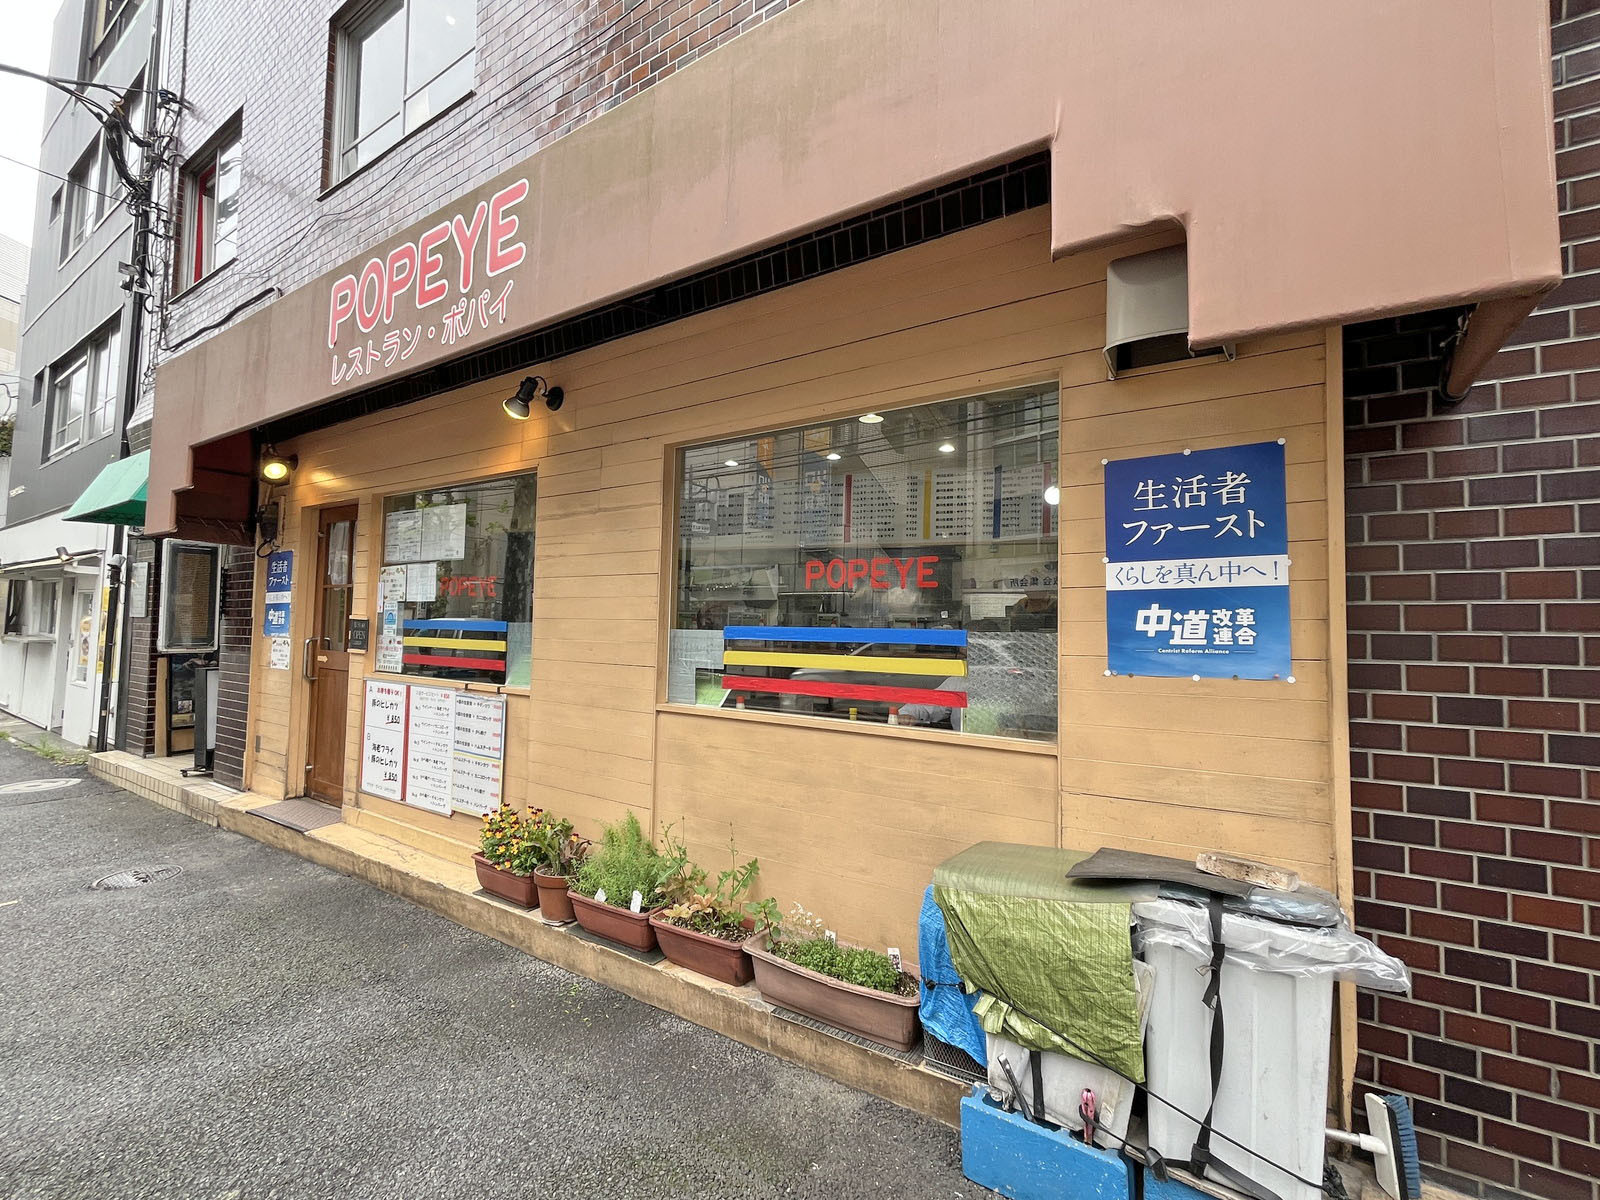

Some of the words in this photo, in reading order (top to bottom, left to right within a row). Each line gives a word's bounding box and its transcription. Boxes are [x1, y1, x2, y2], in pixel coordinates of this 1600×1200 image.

[328, 178, 529, 349] POPEYE
[332, 280, 513, 386] レストラン・ポパイ
[1133, 471, 1252, 512] 生活者
[1122, 509, 1266, 546] ファースト
[440, 576, 497, 597] POPEYE
[805, 555, 940, 590] POPEYE
